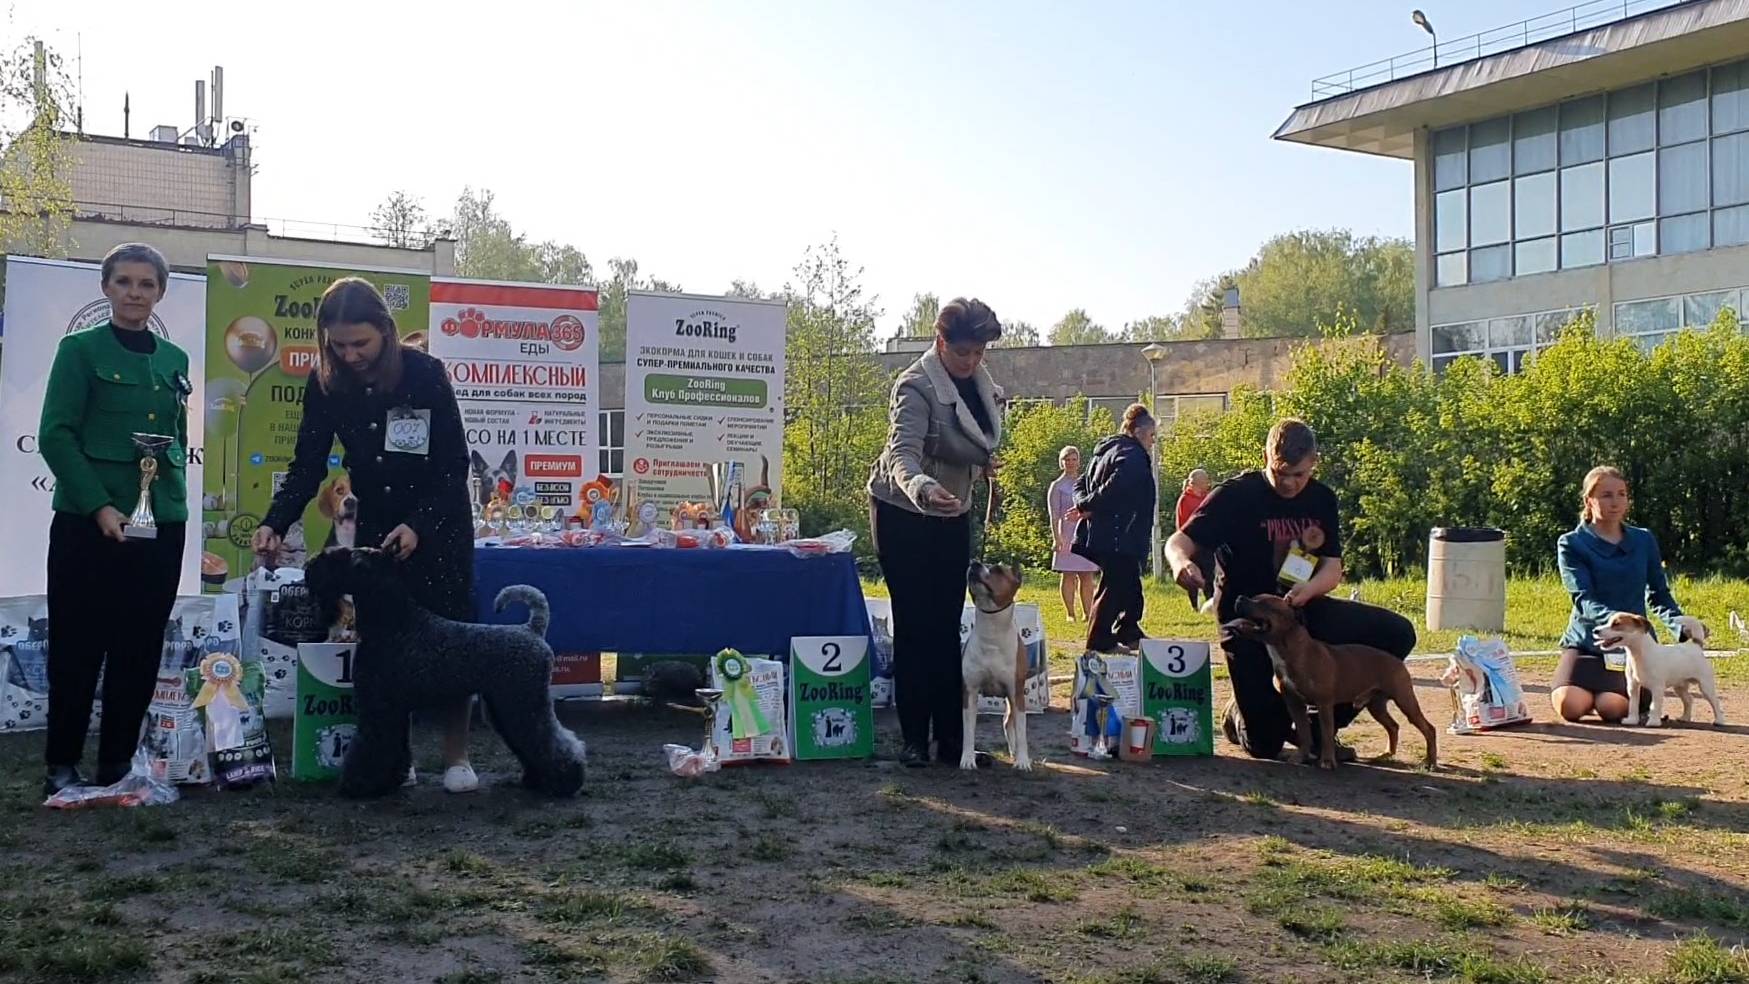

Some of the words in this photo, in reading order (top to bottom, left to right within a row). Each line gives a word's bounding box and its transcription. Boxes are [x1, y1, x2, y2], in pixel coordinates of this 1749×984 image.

[284, 327, 316, 340] КОНК
[675, 318, 737, 343] ZooRing
[520, 343, 550, 356] ЕДЫ
[639, 346, 686, 358] ЭКОКОРМА
[687, 348, 706, 359] ДЛЯ
[708, 349, 737, 360] КОШЕК
[739, 352, 745, 361] И
[747, 352, 774, 362] СОБАК
[289, 351, 321, 368] ПРИ
[636, 358, 733, 373] СУПЕР-ПРЕМИАЛЬНОГО
[735, 365, 776, 375] КАЧЕСТВА
[687, 378, 726, 392] ZooRing
[271, 385, 305, 406] ПОД
[471, 388, 491, 398] для
[493, 388, 525, 399] собак
[528, 390, 552, 399] всех
[555, 391, 587, 401] пород
[651, 387, 676, 400] Клуб
[678, 389, 760, 404] Профессионалов
[285, 410, 299, 420] ЕЩ
[278, 422, 299, 433] НАШ
[466, 428, 491, 446] СО
[497, 429, 516, 446] НА
[523, 429, 529, 446] 1
[534, 430, 587, 447] МЕСТЕ
[530, 461, 577, 471] ПРЕМИУМ
[336, 649, 353, 683] 1
[821, 643, 842, 672] 2
[1168, 645, 1186, 674] 3
[799, 683, 865, 704] ZooRing
[1147, 682, 1206, 706] ZooRing
[303, 694, 353, 716] ZooR
